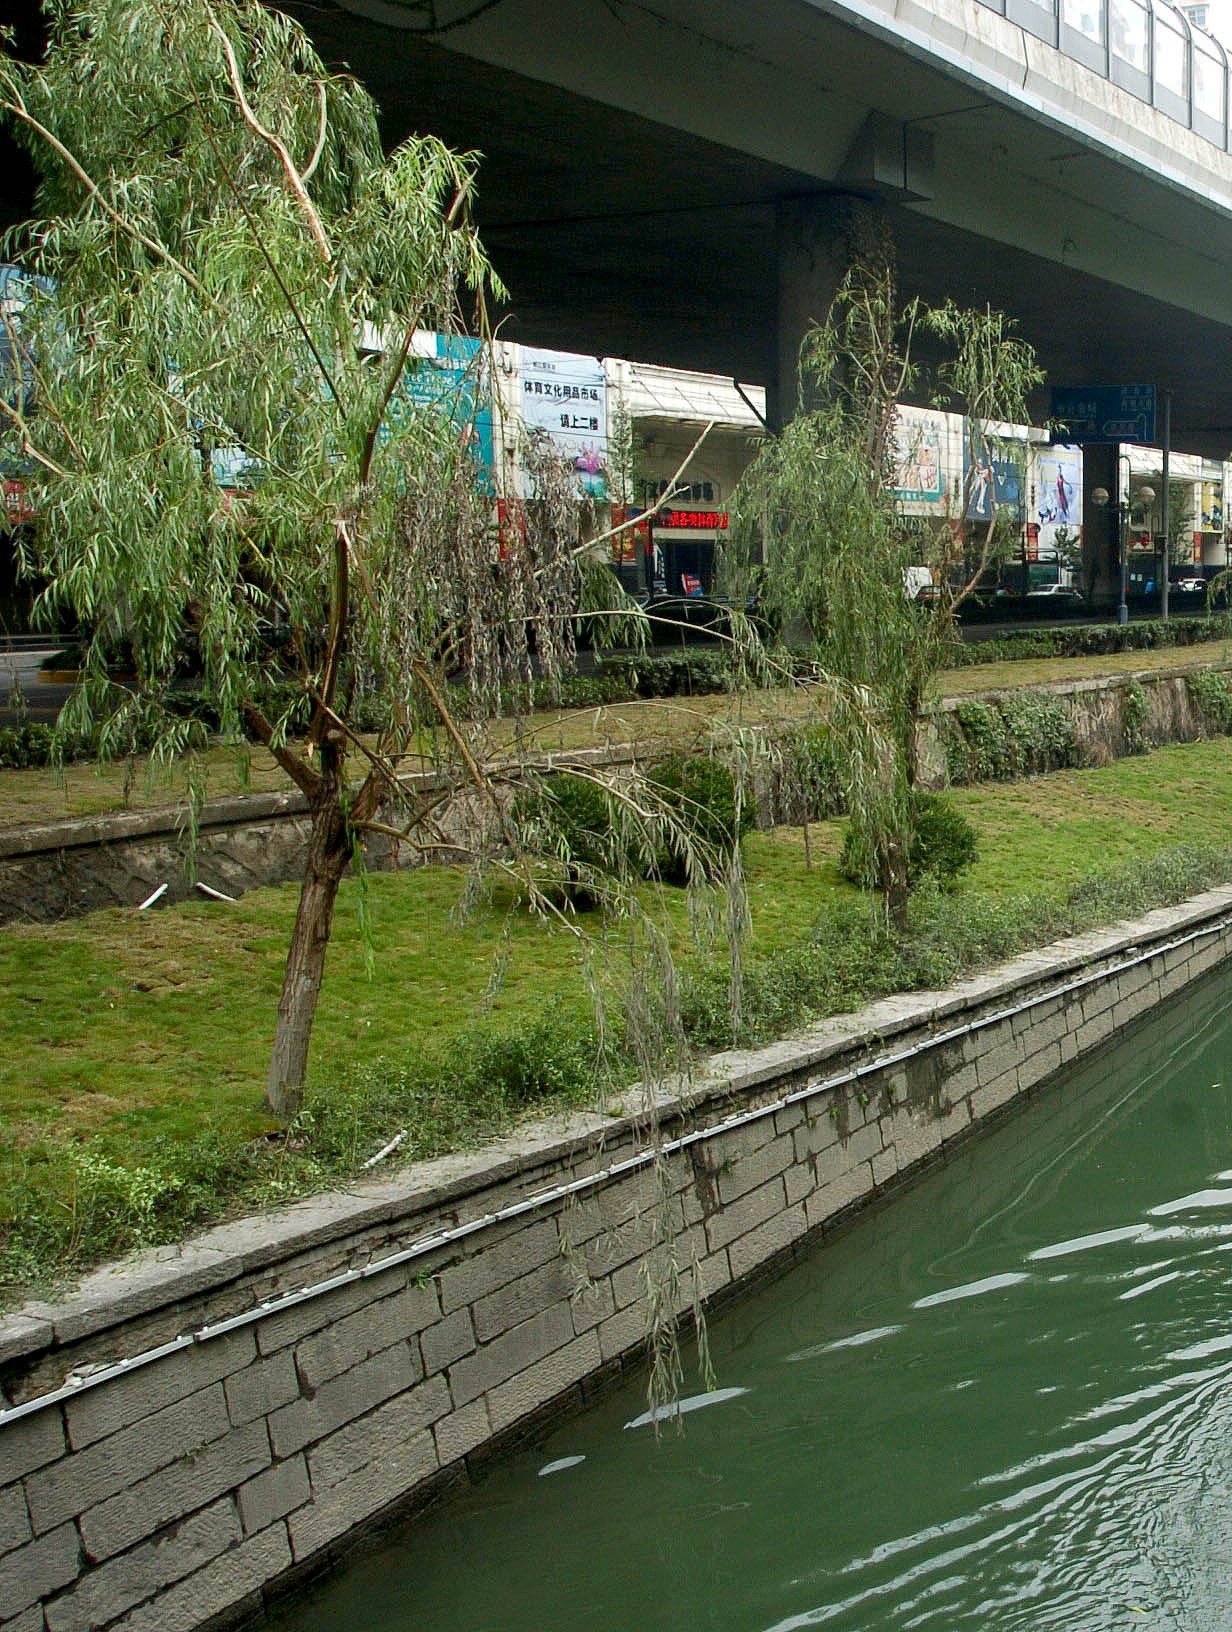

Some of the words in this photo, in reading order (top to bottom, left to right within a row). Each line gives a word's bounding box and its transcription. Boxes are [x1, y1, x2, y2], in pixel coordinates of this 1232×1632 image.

[524, 380, 598, 400] 体育文化用品市场
[560, 413, 598, 431] 请上二楼
